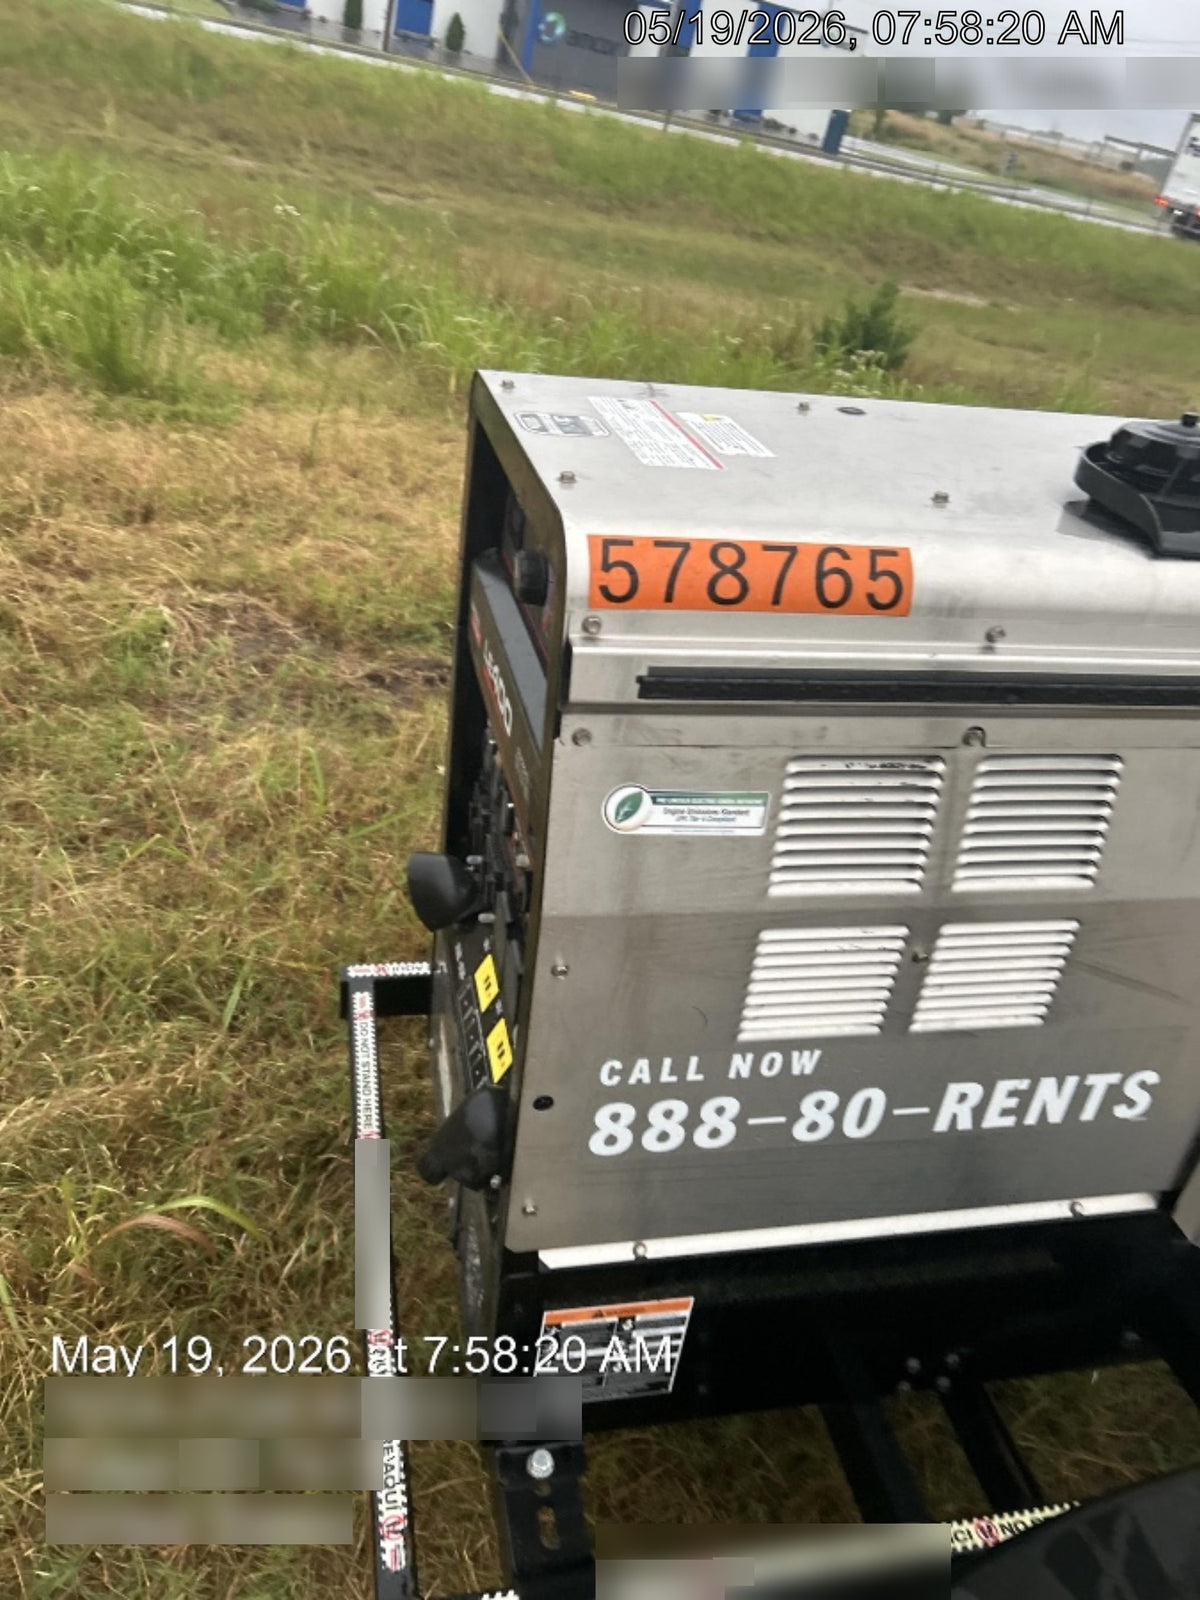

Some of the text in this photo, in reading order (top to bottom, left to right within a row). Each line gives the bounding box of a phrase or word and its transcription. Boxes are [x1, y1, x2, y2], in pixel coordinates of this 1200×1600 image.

[598, 538, 904, 610] 578765
[360, 1060, 372, 1096] STAND
[600, 1049, 822, 1087] CALL NOW
[588, 1070, 1161, 1157] 888-80-RENTS
